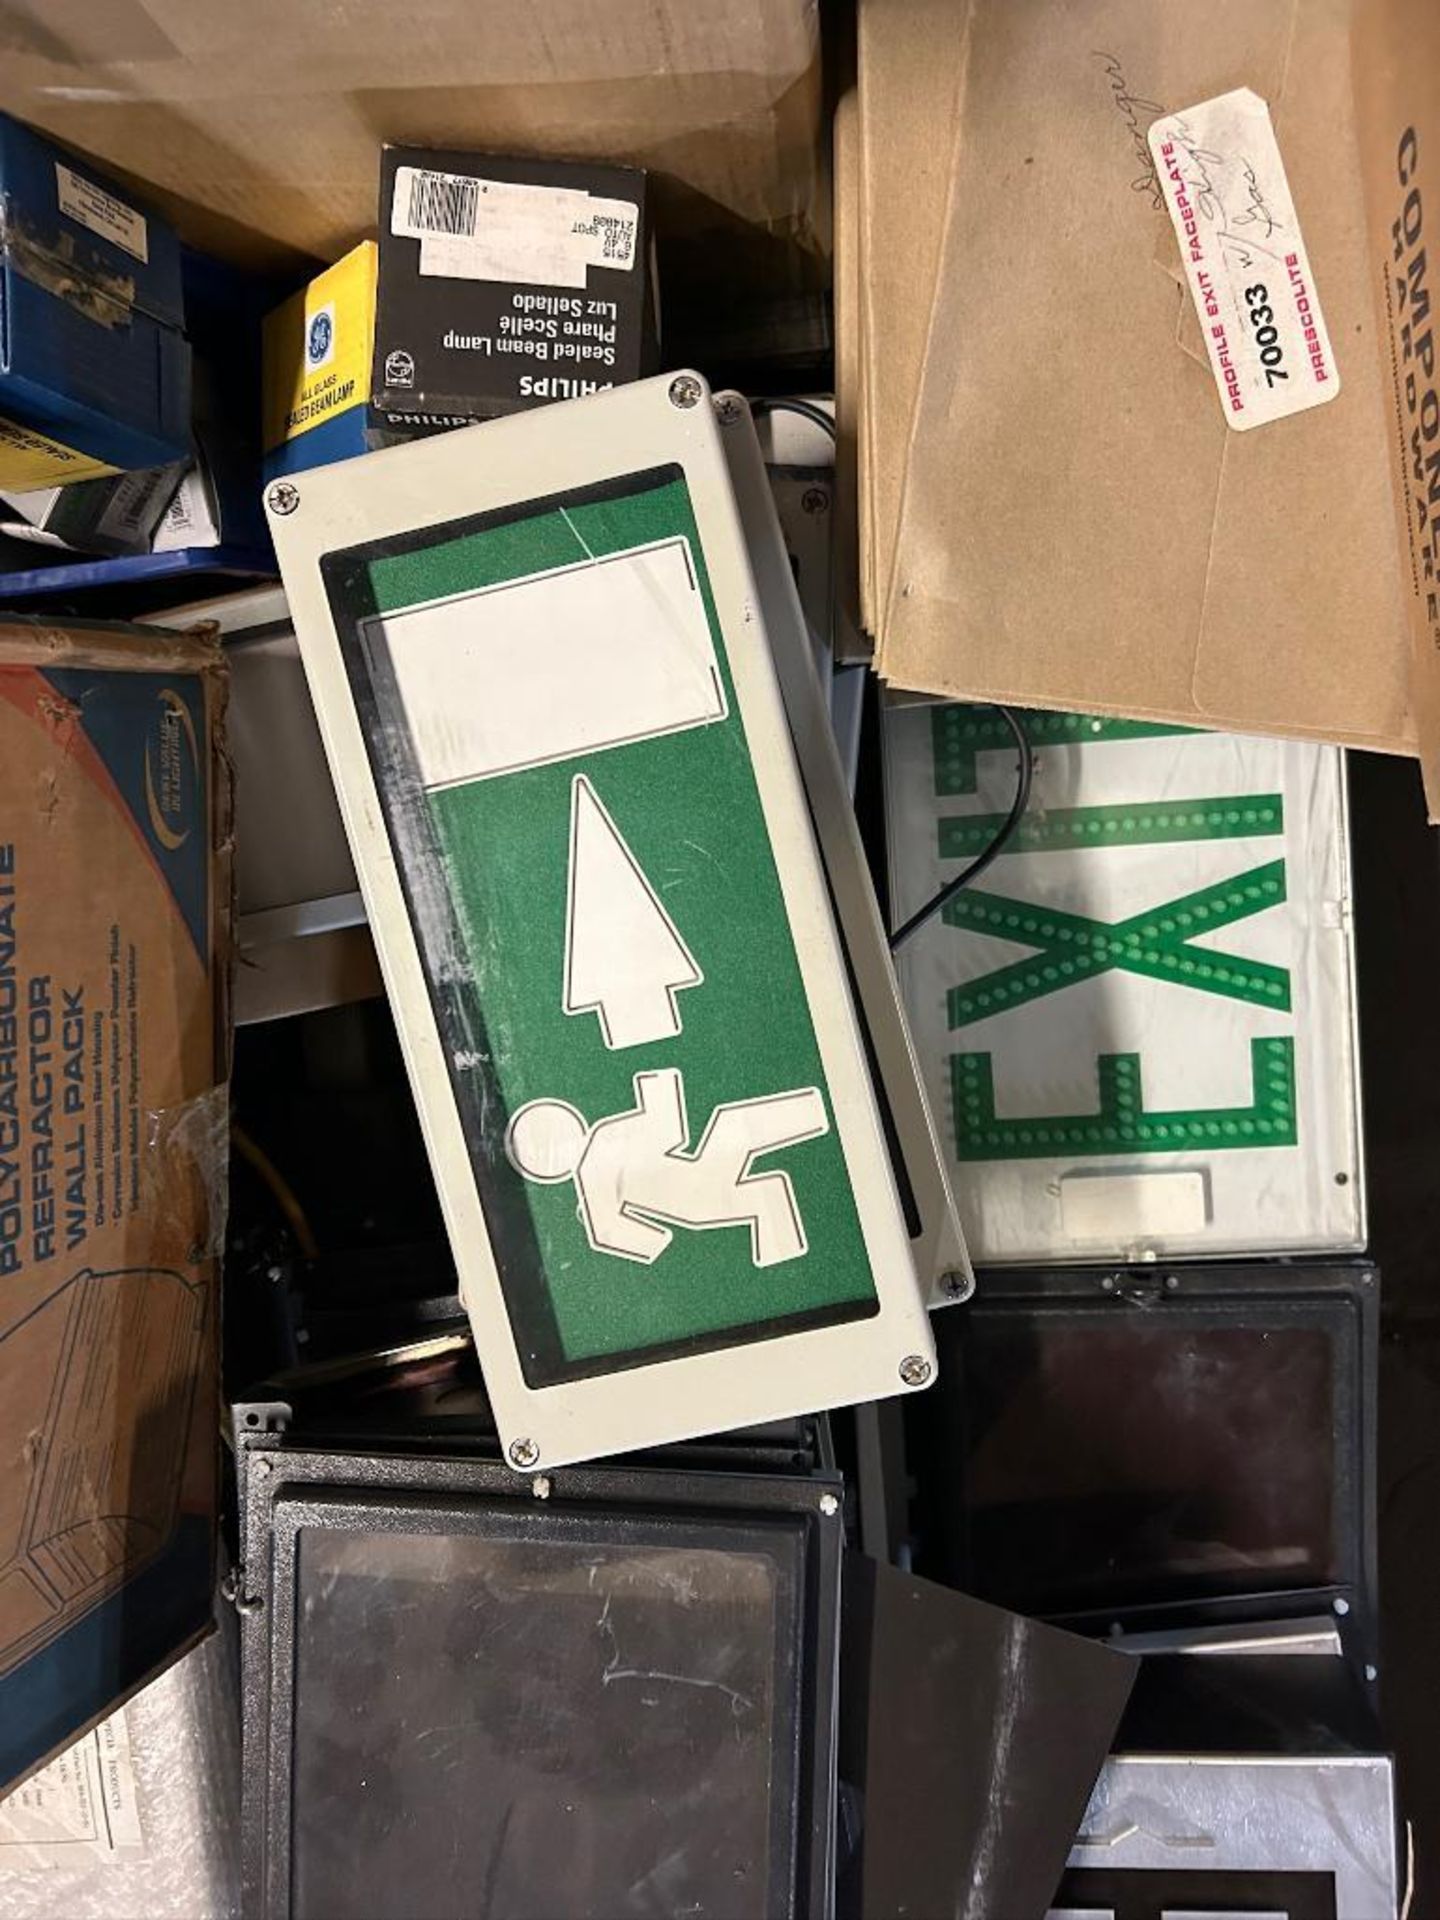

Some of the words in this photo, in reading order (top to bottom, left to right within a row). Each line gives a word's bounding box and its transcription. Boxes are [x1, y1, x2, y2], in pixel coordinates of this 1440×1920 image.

[1160, 141, 1203, 261] FACEPLATE
[500, 316, 558, 338] Scellé
[513, 294, 583, 317] Sellado
[563, 321, 616, 343] Phare
[587, 301, 617, 321] Luz
[1197, 270, 1220, 315] EXIT
[1244, 282, 1289, 388] 70033
[1285, 252, 1328, 383] PRESCOLITE
[443, 329, 492, 356] Lamp
[496, 338, 548, 360] Beam
[553, 343, 615, 366] Sealed
[1205, 324, 1244, 411] PROFILE
[1397, 126, 1440, 585] COMPON
[310, 391, 332, 417] BEAM
[333, 379, 355, 406] LAMP
[1391, 216, 1438, 623] HARDWARE
[930, 705, 1298, 1162] EXIT
[0, 843, 22, 1276] POLYCARBONATE
[62, 984, 86, 1115] PACK
[92, 1011, 103, 1065] Housing
[28, 975, 56, 1263] REFRACTOR
[62, 1125, 88, 1252] WALL
